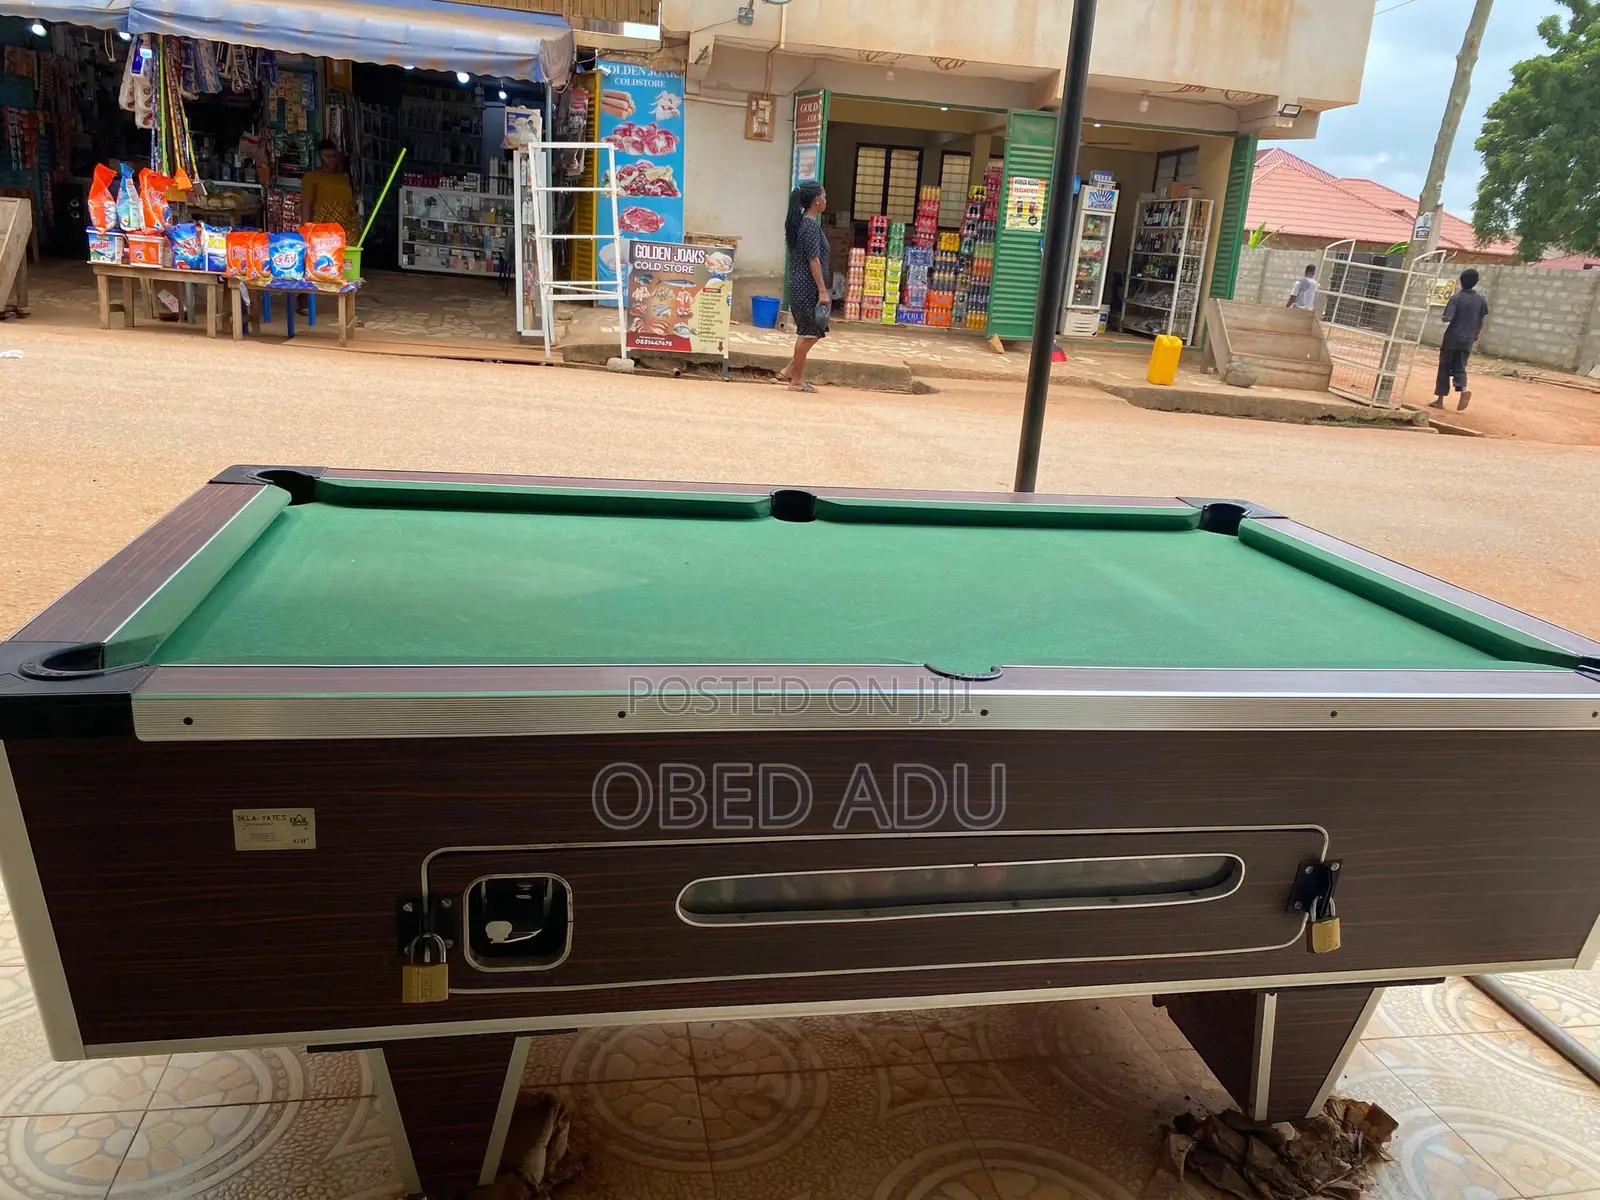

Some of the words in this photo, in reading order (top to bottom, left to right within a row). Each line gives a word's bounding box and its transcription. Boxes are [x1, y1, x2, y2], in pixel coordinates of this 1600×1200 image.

[614, 77, 666, 88] COLDSTORE
[635, 244, 671, 261] GOLDEN
[673, 248, 705, 264] JOAKS
[634, 261, 662, 271] COLD
[663, 263, 695, 274] STORE
